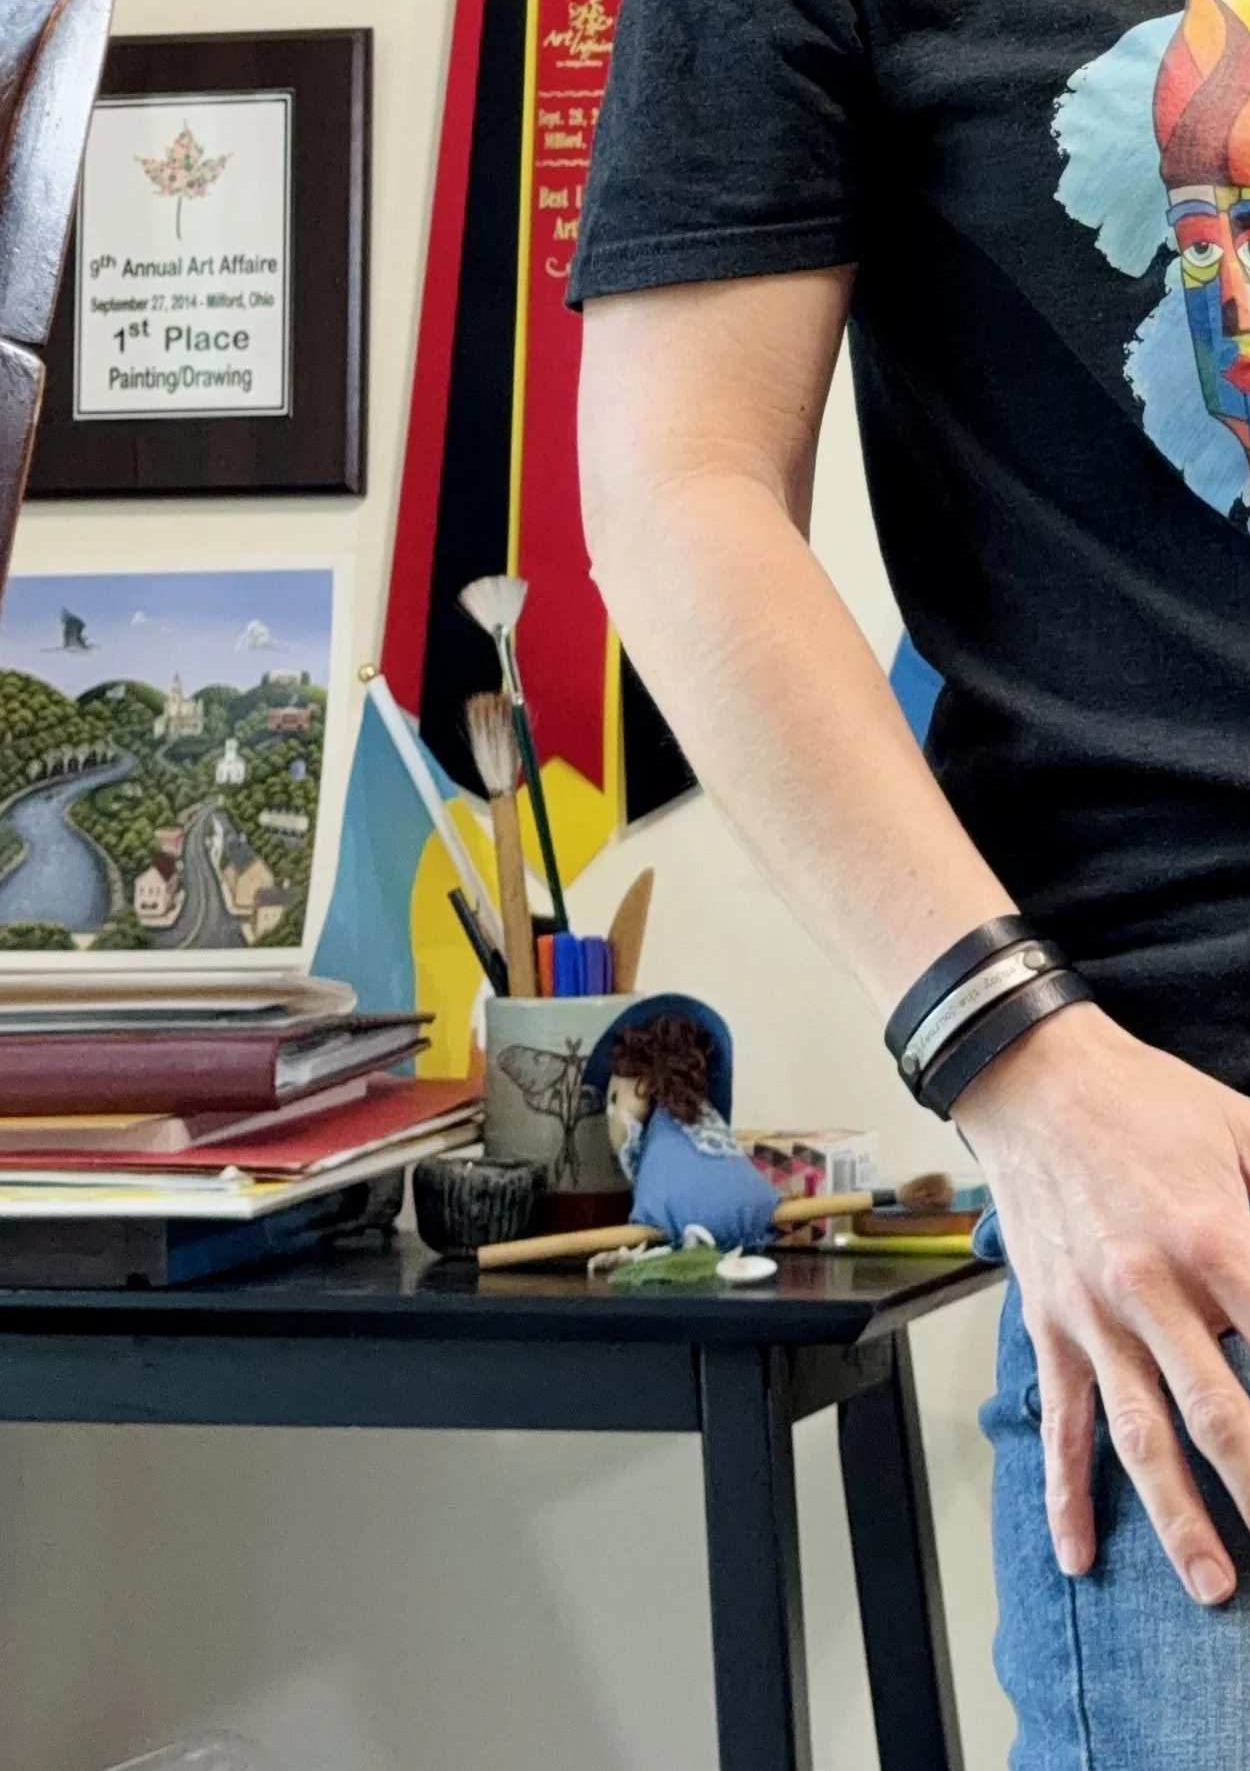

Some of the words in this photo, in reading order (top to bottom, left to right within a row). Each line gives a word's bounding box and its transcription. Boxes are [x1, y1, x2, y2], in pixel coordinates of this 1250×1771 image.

[539, 186, 569, 209] Best
[89, 254, 117, 280] 9th
[122, 256, 182, 278] Annual
[187, 256, 215, 277] Art
[219, 254, 277, 276] Affaire
[90, 295, 148, 317] September
[171, 294, 198, 311] 2014
[206, 291, 246, 311] Milford,
[249, 290, 275, 308] Ohio
[113, 319, 151, 354] 1st
[164, 326, 250, 352] Place
[109, 365, 253, 394] Painting/Drawing
